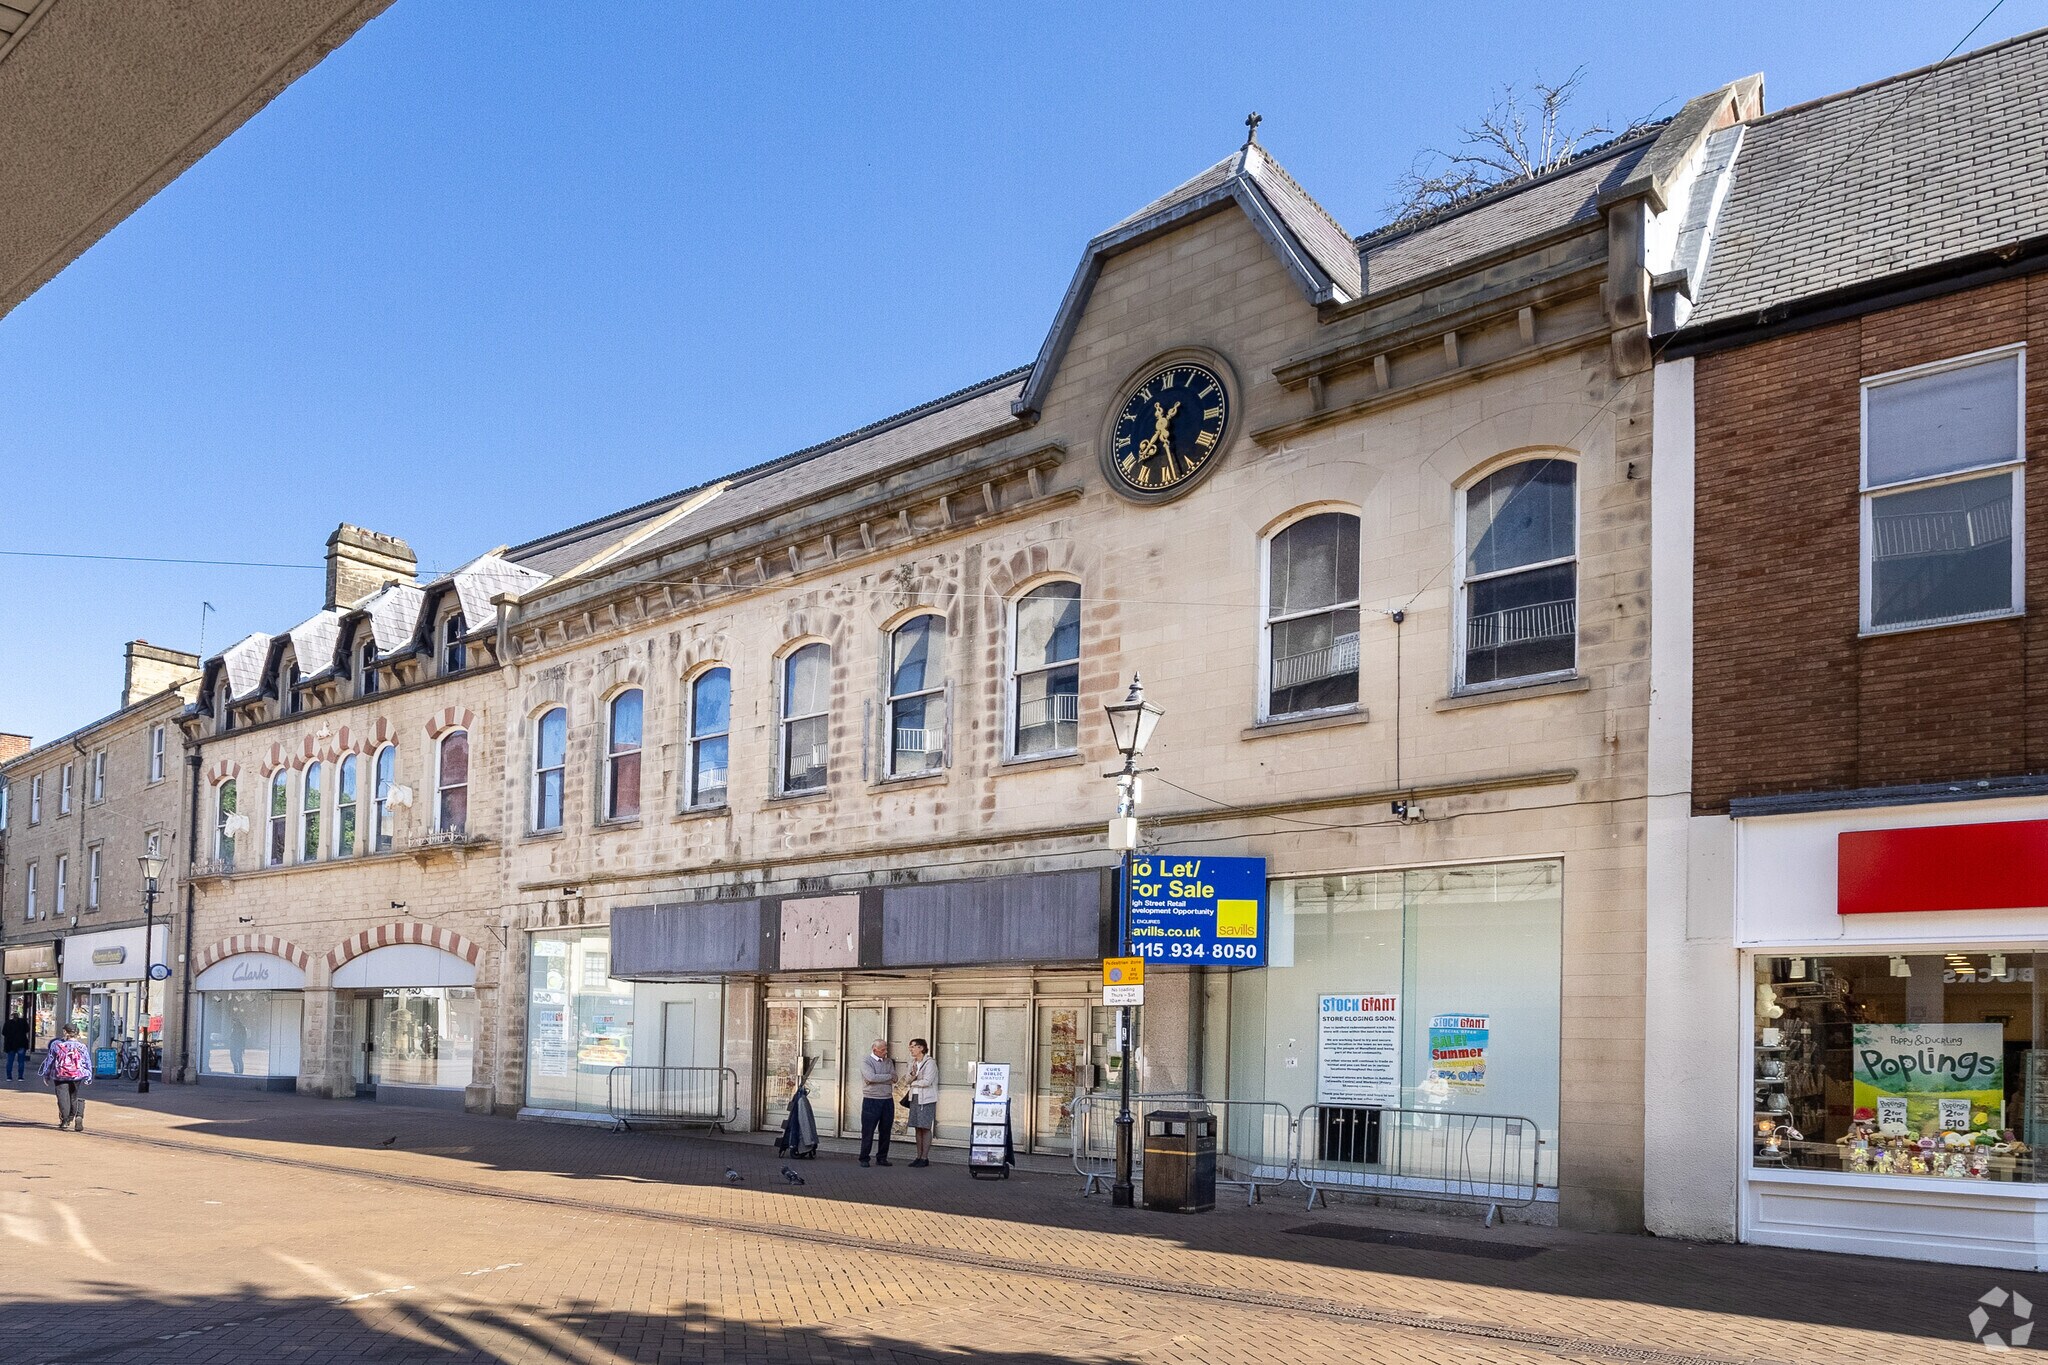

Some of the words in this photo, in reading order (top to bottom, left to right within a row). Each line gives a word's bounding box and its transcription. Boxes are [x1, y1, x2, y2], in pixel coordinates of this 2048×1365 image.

[1160, 860, 1201, 878] Let/
[1169, 880, 1214, 898] Sale
[1132, 926, 1200, 937] avills.co.uk
[1219, 924, 1255, 936] savills
[1171, 943, 1205, 958] 934
[1212, 944, 1257, 958] 8050
[232, 962, 269, 981] Clarks
[1323, 998, 1359, 1012] STOCK
[1362, 997, 1396, 1012] GIANT
[1434, 1018, 1458, 1028] STOCK
[1460, 1018, 1485, 1028] GIANT
[1432, 1034, 1467, 1048] SALE!
[1891, 1036, 1913, 1046] Poppy
[1914, 1035, 1924, 1046] &
[1432, 1048, 1483, 1060] Summer
[1860, 1048, 1996, 1082] Poplings
[1458, 1071, 1484, 1081] OFF
[1880, 1100, 1905, 1108] Poplings
